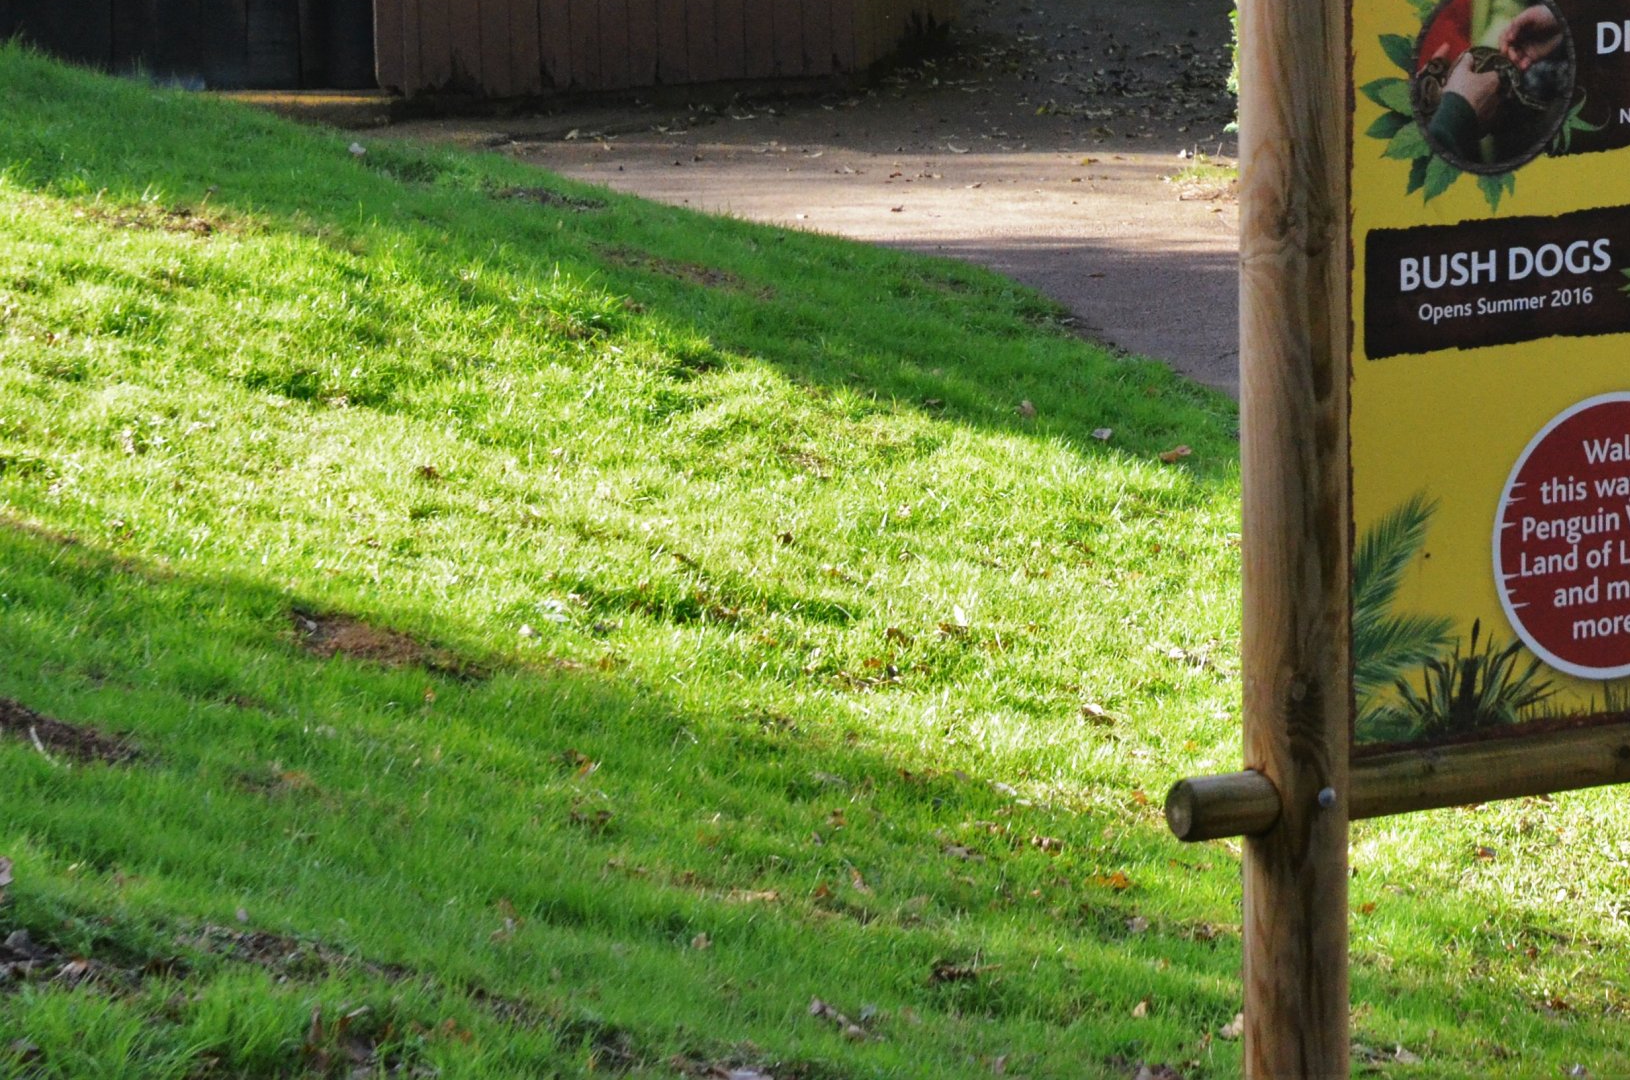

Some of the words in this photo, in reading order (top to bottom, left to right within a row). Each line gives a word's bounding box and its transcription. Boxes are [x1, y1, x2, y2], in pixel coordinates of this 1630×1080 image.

[1400, 248, 1498, 293] BUSH
[1508, 238, 1613, 282] DOGS
[1418, 302, 1473, 327] Opens
[1476, 294, 1547, 315] Summer
[1550, 286, 1594, 308] 2016
[1540, 475, 1587, 505] this
[1521, 508, 1620, 544] Penguin
[1520, 545, 1578, 577] Land
[1586, 541, 1613, 569] of
[1553, 578, 1598, 608] and
